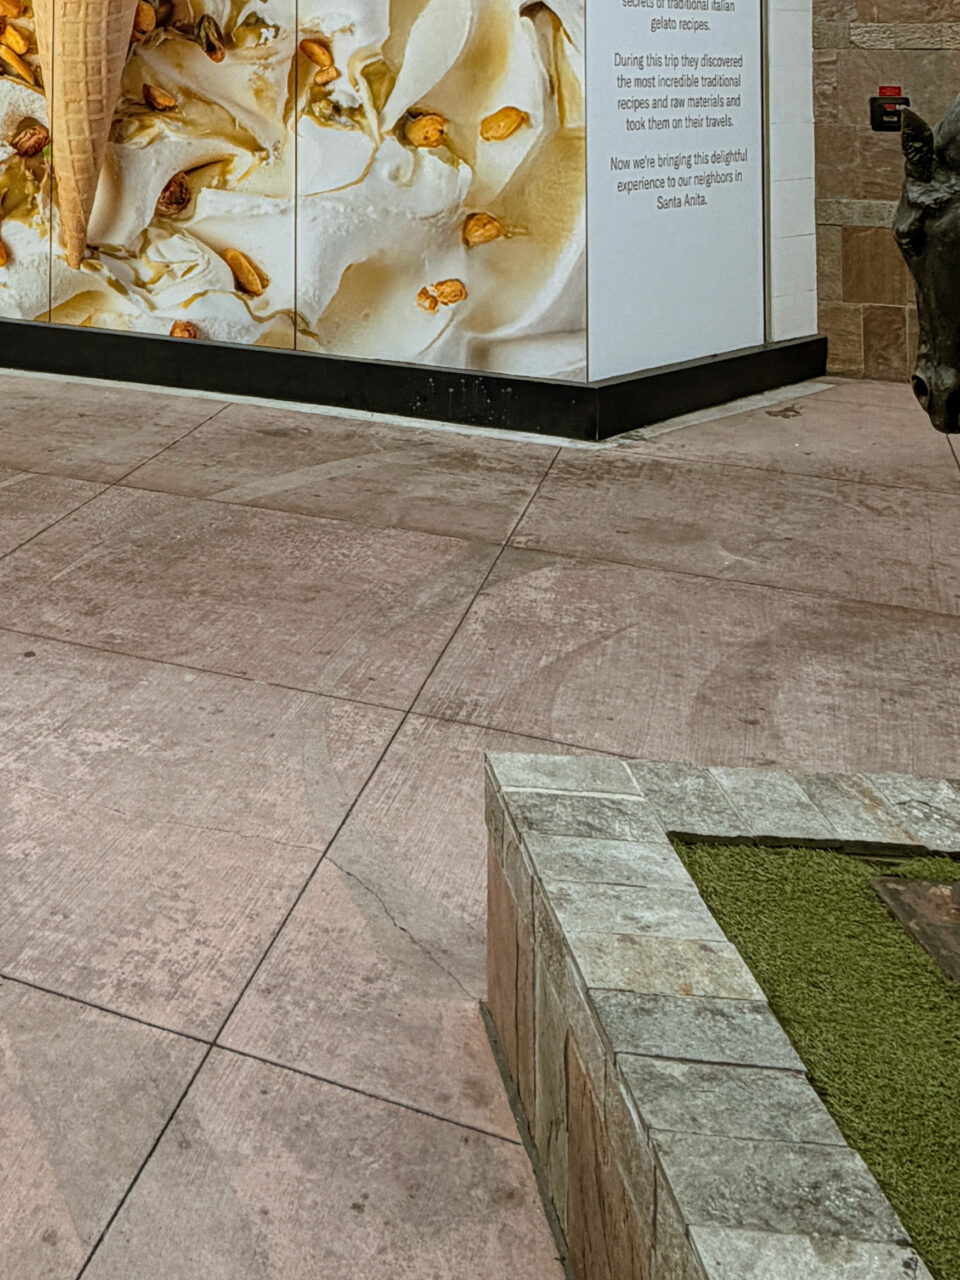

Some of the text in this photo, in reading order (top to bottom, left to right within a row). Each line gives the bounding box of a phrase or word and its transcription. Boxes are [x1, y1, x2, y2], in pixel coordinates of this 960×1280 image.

[651, 17, 710, 32] gelato recipes.
[614, 53, 742, 69] During this trip they discovered
[617, 74, 741, 88] the most incredible traditional
[618, 94, 740, 112] recipes and raw materials and
[626, 115, 733, 131] took them on their travels.
[610, 148, 748, 171] Now we're bringing this delightful
[617, 171, 742, 195] experience to our neighbors in
[657, 193, 707, 210] Santa Anita.
